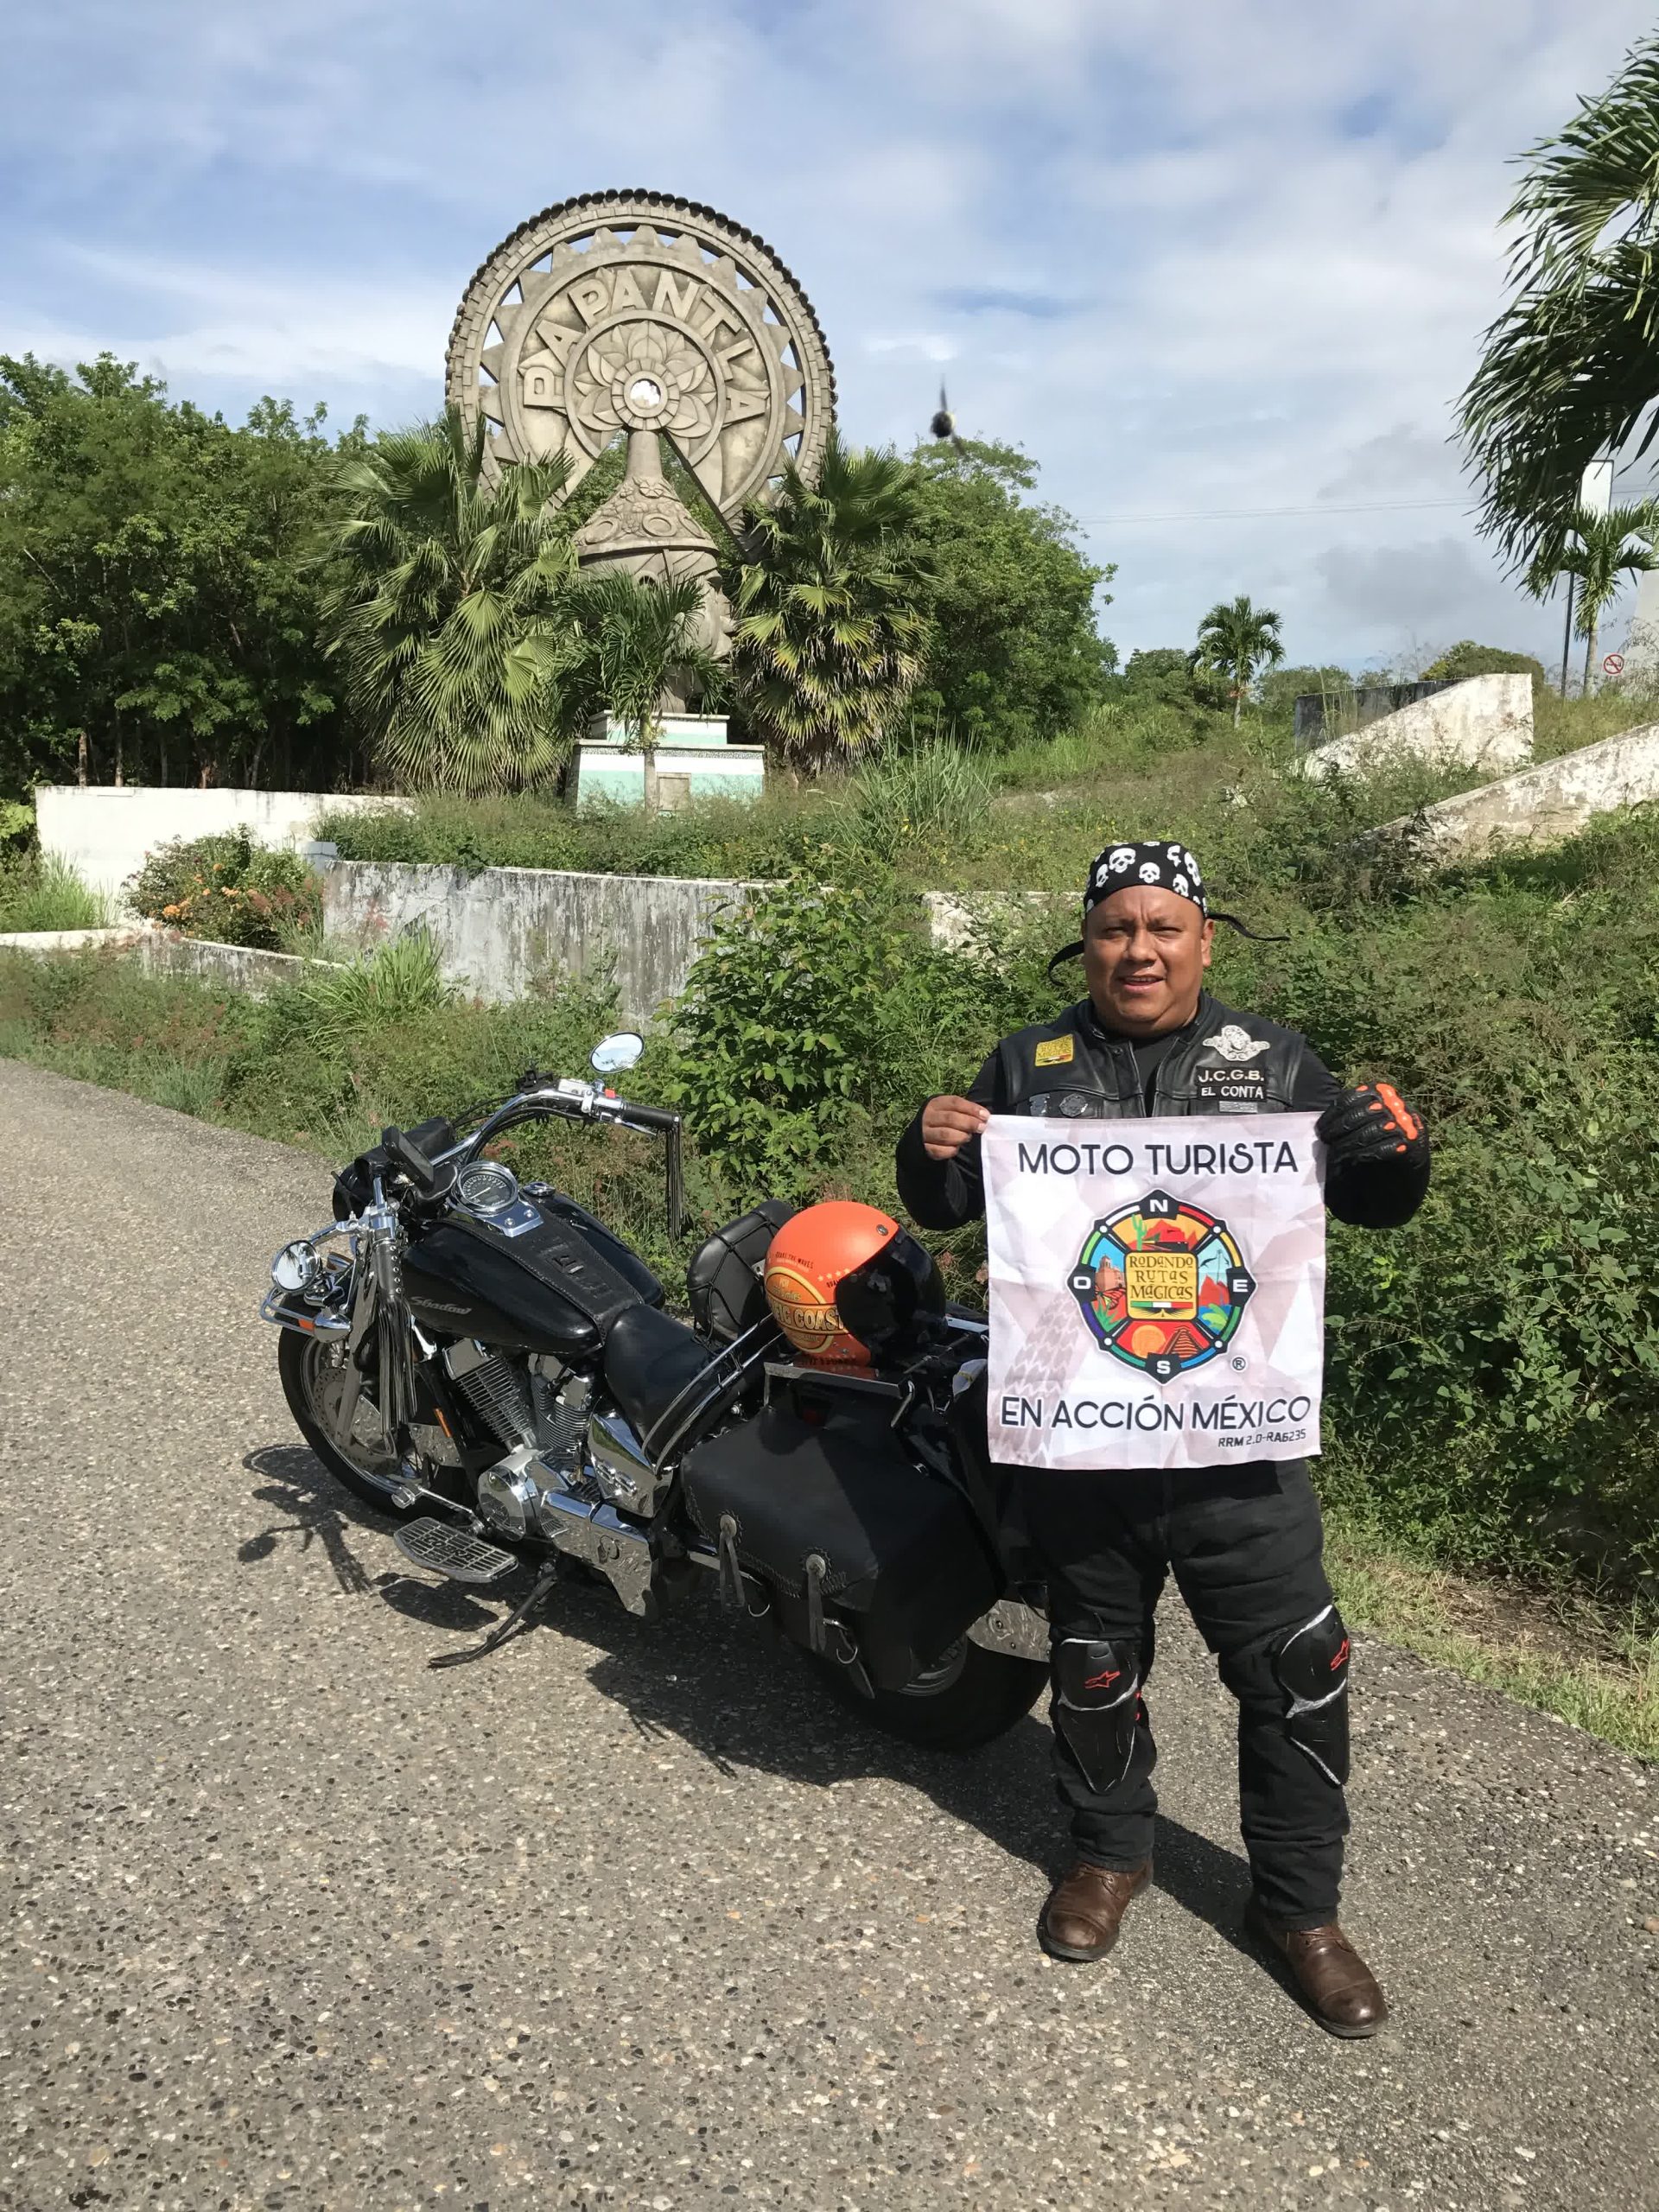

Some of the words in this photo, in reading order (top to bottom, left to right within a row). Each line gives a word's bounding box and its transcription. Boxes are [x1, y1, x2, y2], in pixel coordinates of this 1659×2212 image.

[522, 267, 770, 426] PAPANTLA
[1198, 1070, 1264, 1083] J.C.G.B.
[1201, 1086, 1216, 1096] EL
[1220, 1085, 1264, 1099] CONTA
[1018, 1142, 1134, 1175] MOTO
[1144, 1141, 1299, 1175] TURISTA
[1149, 1199, 1169, 1212] N
[1073, 1276, 1092, 1289] O
[1232, 1279, 1249, 1293] E
[411, 1296, 473, 1314] Shadow
[1156, 1360, 1171, 1374] S
[1001, 1396, 1042, 1427] EN
[1052, 1395, 1184, 1431] ACCIÓN
[1192, 1395, 1311, 1429] MÉXICO
[1218, 1437, 1243, 1447] RRM
